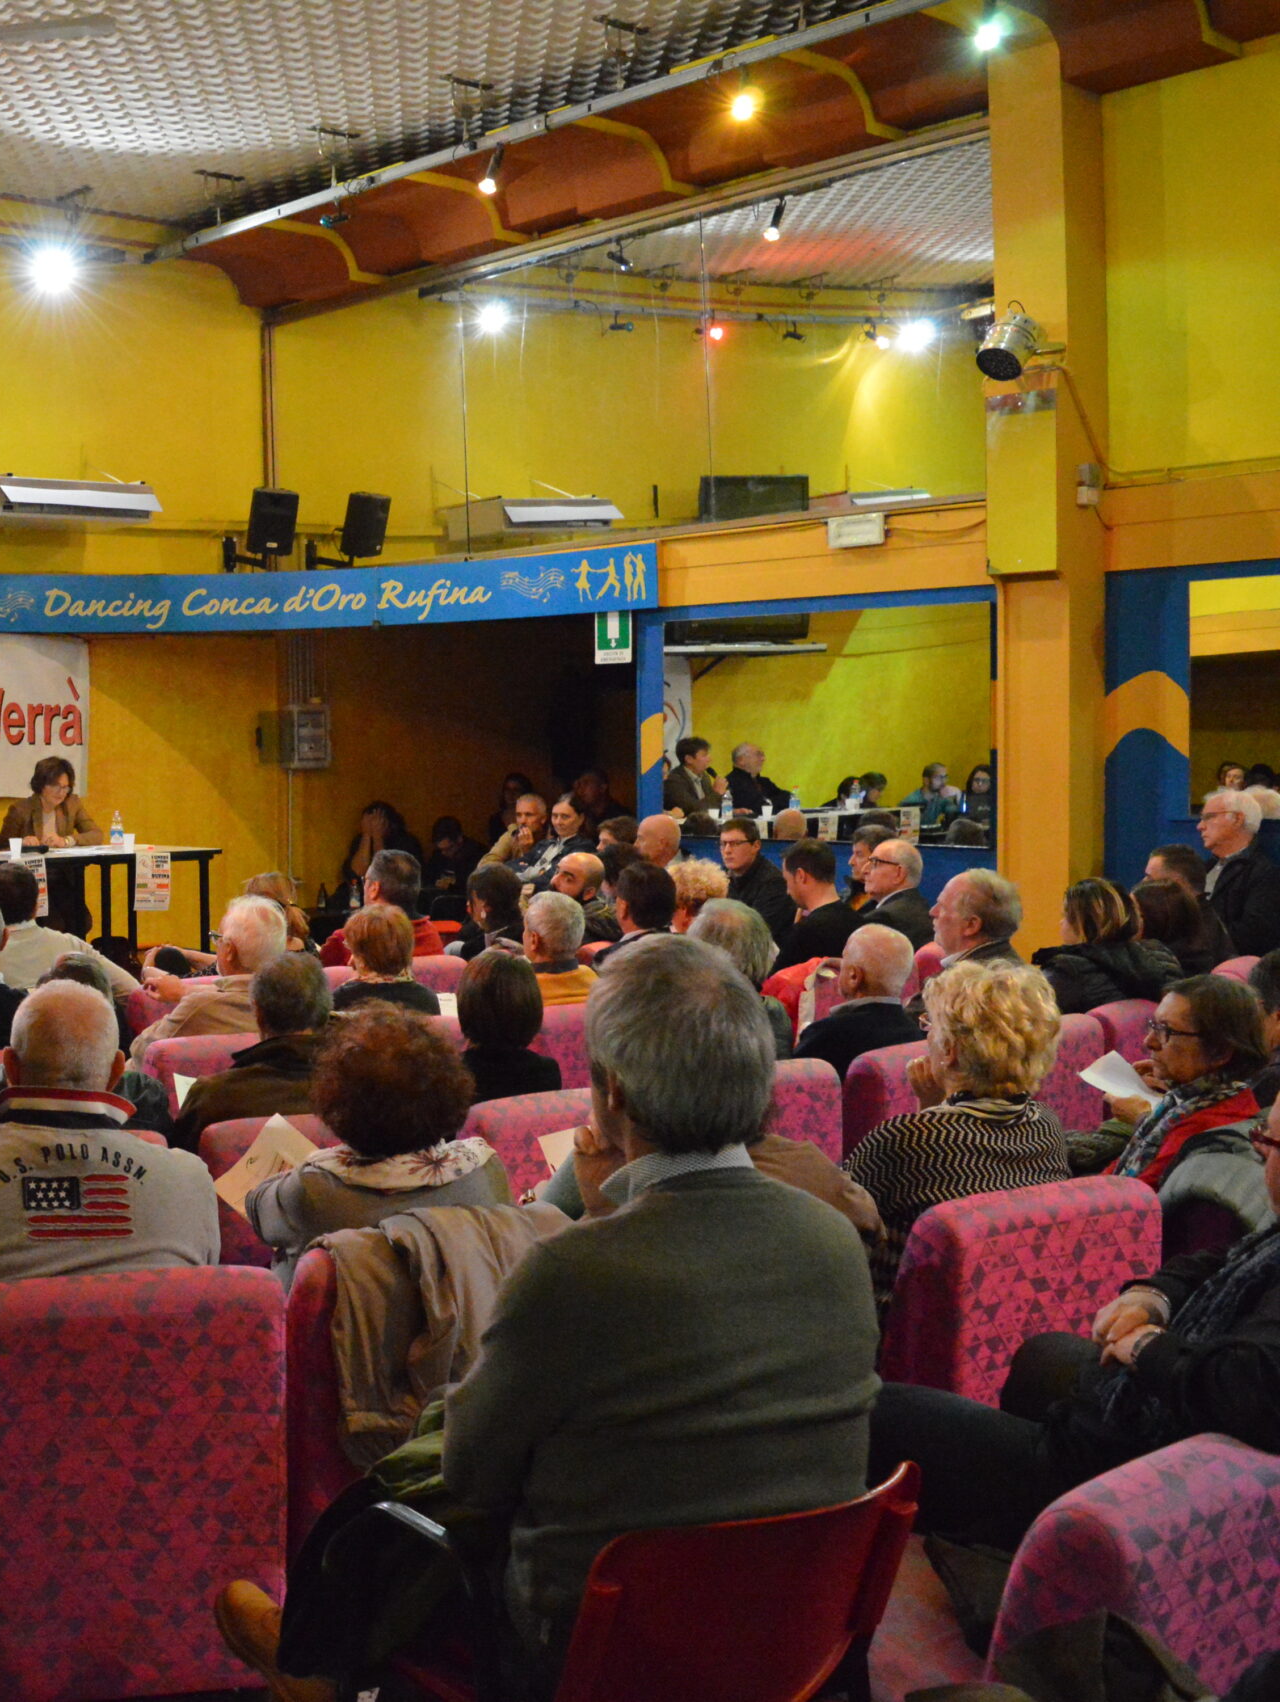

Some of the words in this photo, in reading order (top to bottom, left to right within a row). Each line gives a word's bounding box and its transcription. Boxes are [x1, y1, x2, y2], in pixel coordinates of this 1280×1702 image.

[43, 588, 171, 630] Dancing
[182, 588, 279, 617] Conca
[376, 579, 492, 620] Rufina
[40, 1143, 90, 1163] POLO
